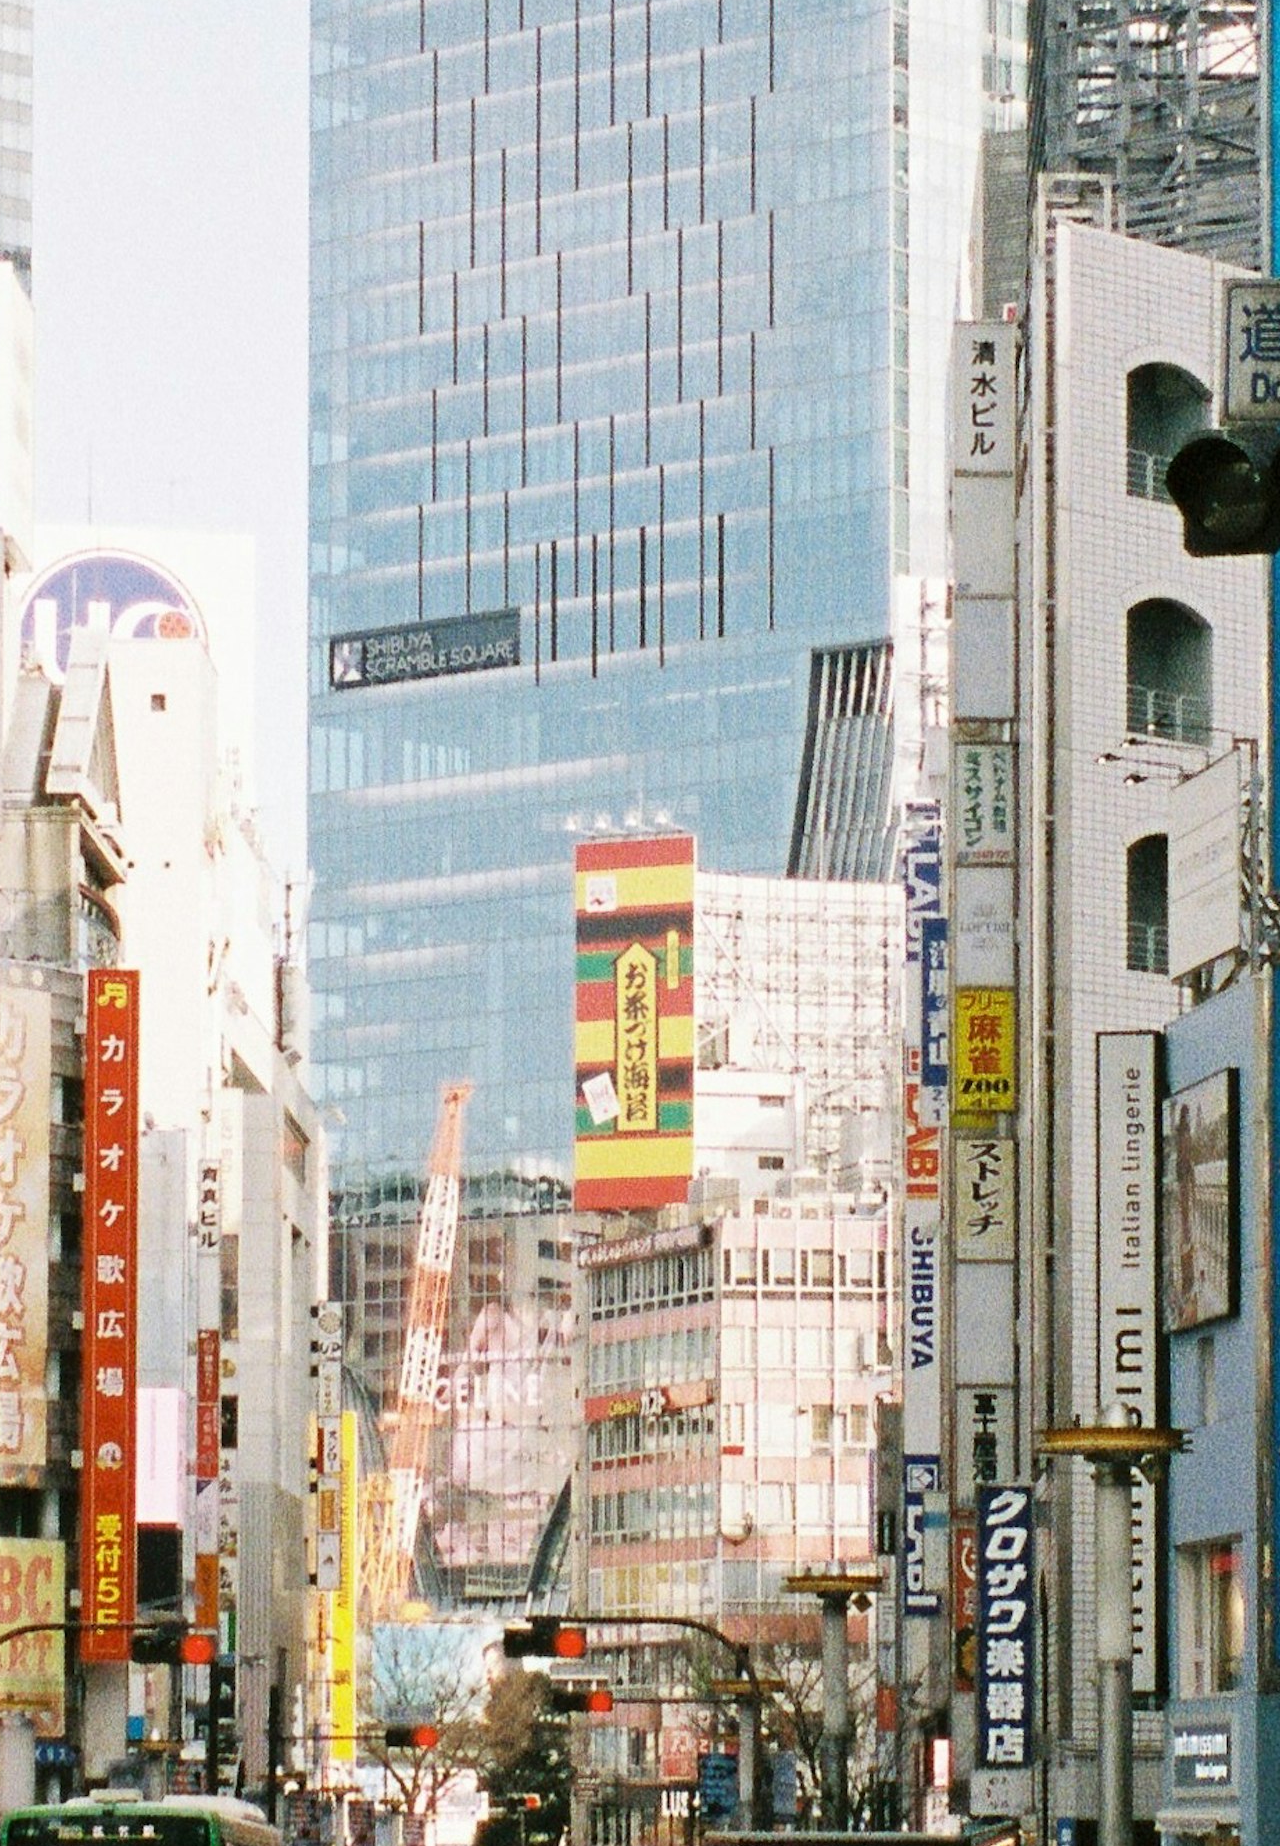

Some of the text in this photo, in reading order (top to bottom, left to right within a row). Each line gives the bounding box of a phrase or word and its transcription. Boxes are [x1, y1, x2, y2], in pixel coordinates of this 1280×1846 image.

[969, 339, 998, 457] 清水ビル
[364, 639, 513, 680] SCRAMBLE SQUARE
[365, 630, 433, 658] SHIBUYA
[967, 1014, 1003, 1075] 麻雀
[97, 1034, 125, 1397] カラオケ歌広場
[967, 1142, 1002, 1237] ストレッチ
[1122, 1066, 1145, 1269] Italian lingerie
[910, 1226, 934, 1370] SHIBUYA
[436, 1372, 543, 1411] CELINE
[985, 1490, 1028, 1764] クロサワ楽器店
